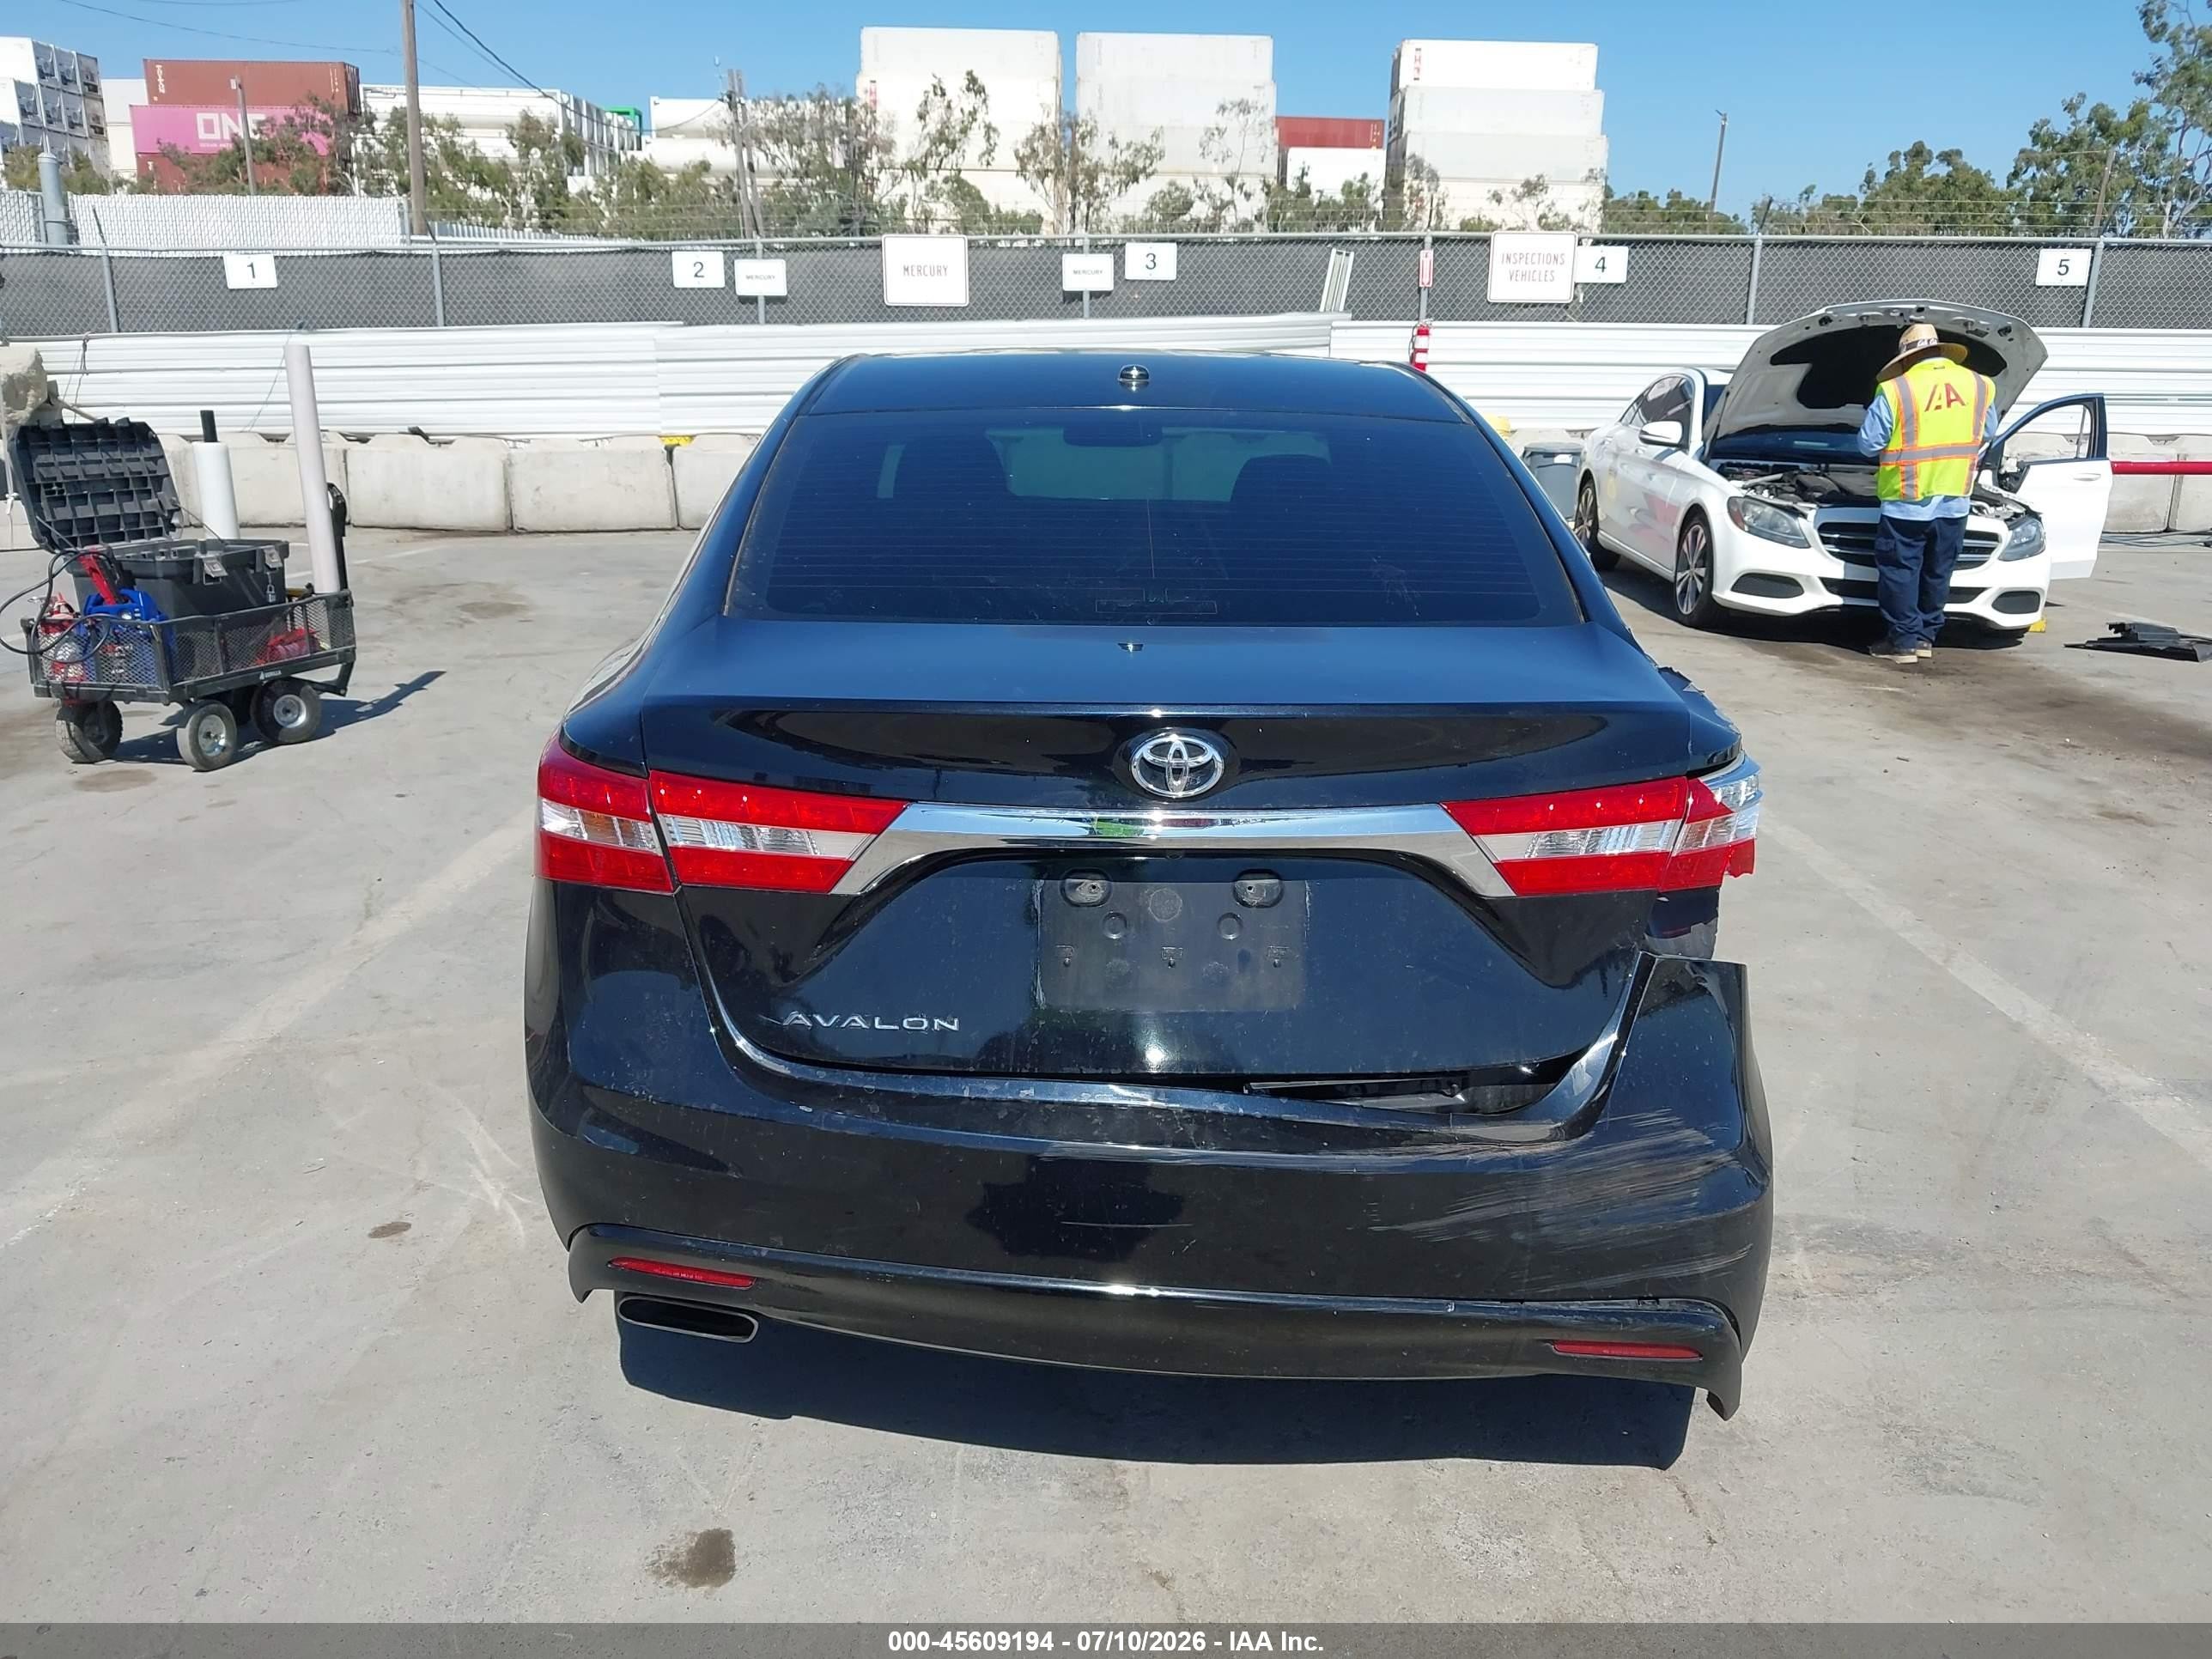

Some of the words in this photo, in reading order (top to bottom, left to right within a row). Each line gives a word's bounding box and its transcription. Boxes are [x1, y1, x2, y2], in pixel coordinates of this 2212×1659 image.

[1146, 252, 1157, 270] 3
[1501, 252, 1565, 265] INSPECTIONS
[1594, 256, 1607, 273] 4
[2057, 258, 2070, 276] 5
[246, 262, 256, 279] 1
[693, 261, 705, 278] 2
[902, 264, 948, 277] MERCURY
[1509, 270, 1555, 283] VEHICLES
[782, 1011, 960, 1032] AVALON
